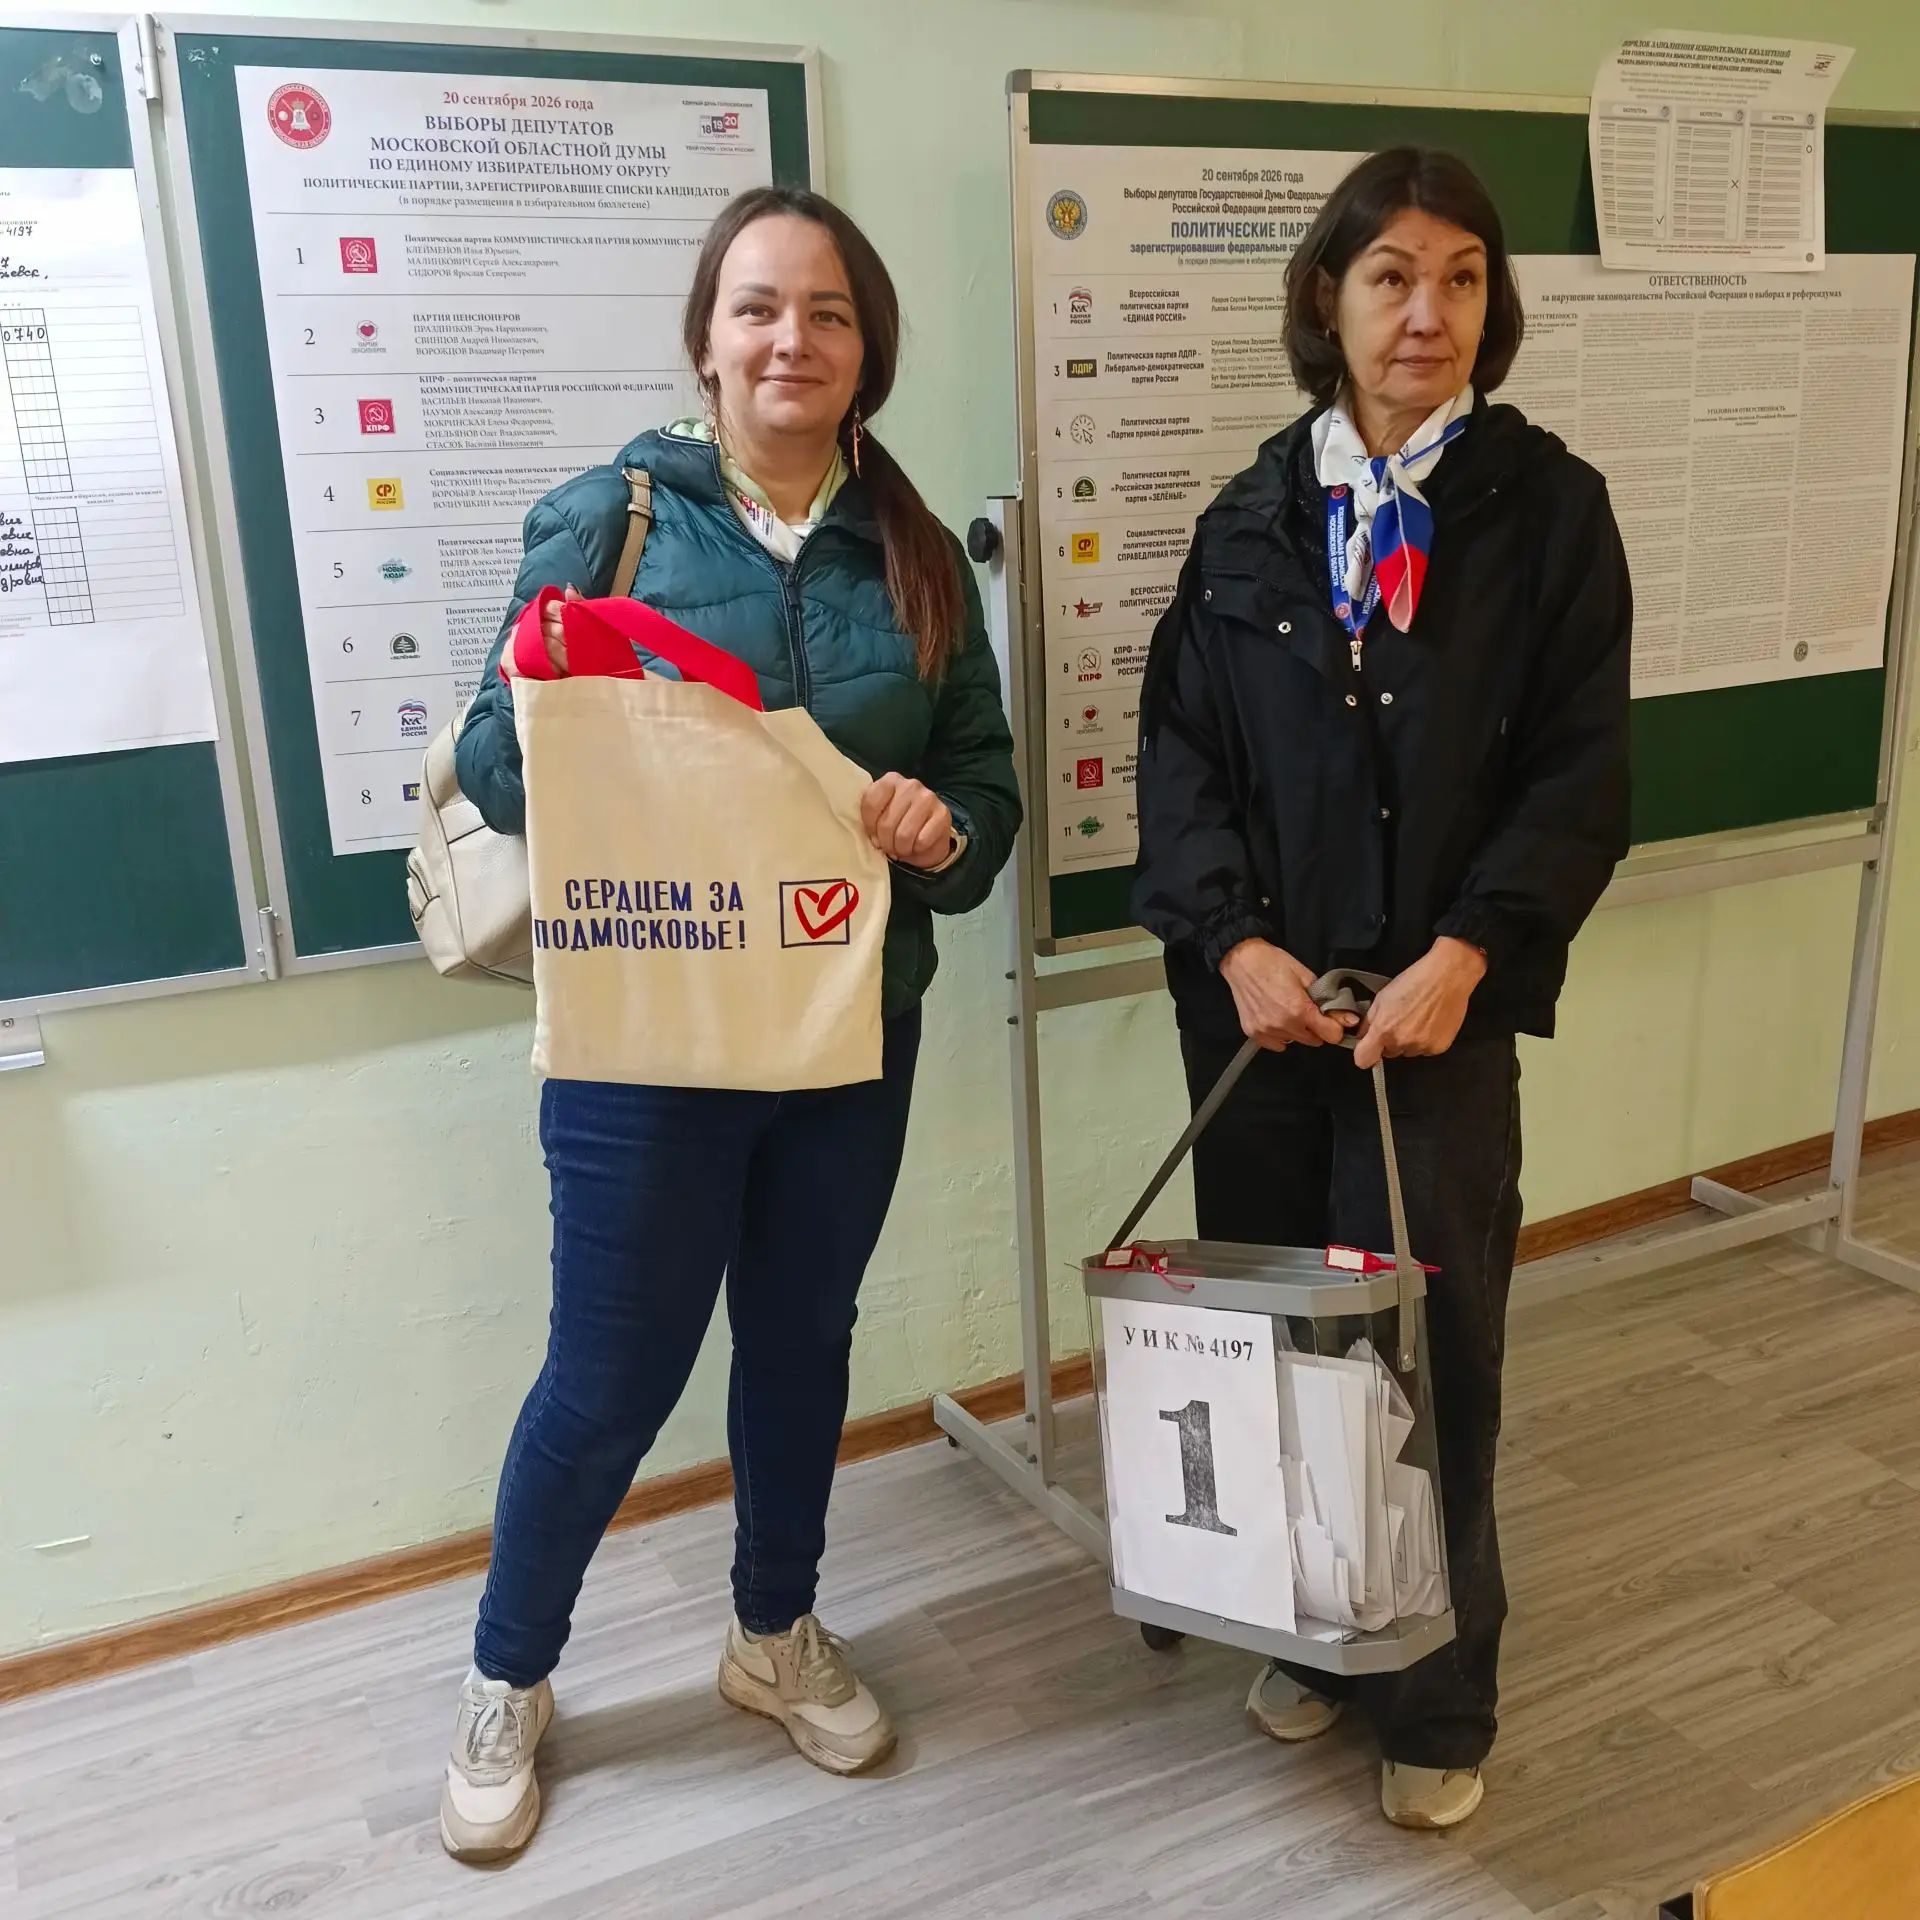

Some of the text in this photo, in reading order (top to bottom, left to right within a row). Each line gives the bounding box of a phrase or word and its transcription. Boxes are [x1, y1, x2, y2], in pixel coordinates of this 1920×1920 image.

[443, 91, 594, 112] 20 сентября 2026 года
[425, 116, 614, 136] ВЫБОРЫ ДЕПУТАТОВ
[713, 120, 723, 130] 19
[724, 116, 737, 126] 20
[702, 125, 711, 134] 18
[370, 137, 666, 160] МОСКОВСКОЙ ОБЛАСТНОЙ ДУМЫ
[369, 158, 670, 178] ПО ЕДИНОМУ ИЗБИРАТЕЛЬНОМУ ОКРУГУ
[1202, 168, 1304, 184] 20 сентября 2026 года
[303, 178, 730, 197] ПОЛИТИЧЕСКИЕ ПАРТИИ, ЗАРЕГИСТРИРОВАВШИЕ СПИСКИ КАНДИДАТОВ
[1123, 188, 1334, 203] Выборы депутатов Государственной Думы Федерально
[398, 195, 409, 206] (в
[411, 197, 452, 207] порядке
[453, 198, 514, 207] размещения
[524, 200, 596, 208] избирательном
[597, 199, 650, 209] бюллетене)
[1172, 203, 1302, 215] Российской Федерации девятого
[6, 226, 33, 237] 4197
[1171, 222, 1311, 240] ПОЛИТИЧЕСКИЕ ПАРТ
[404, 235, 463, 243] Политическая
[493, 235, 594, 244] КОММУНИСТИЧЕСКАЯ
[594, 237, 631, 245] ПАРТИЯ
[632, 237, 695, 246] КОММУНИСТЫ
[1130, 243, 1288, 254] зарегистрировавшие федеральные
[296, 248, 304, 265] 1
[408, 269, 452, 277] СИДОРОВ
[1649, 275, 1747, 286] ОТВЕТСТВЕННОСТЬ
[1129, 289, 1180, 298] Всероссийская
[1551, 294, 1596, 304] нарушение
[1596, 293, 1663, 301] законодательства
[1664, 290, 1707, 300] Российской
[1708, 290, 1748, 300] Федерации
[1754, 290, 1785, 300] выборах
[1792, 290, 1842, 300] референдумах
[1053, 303, 1057, 314] 1
[1119, 302, 1189, 311] политическая партия
[413, 314, 451, 322] ПАРТИЯ
[1122, 313, 1186, 323] «ЕДИНАЯ РОССИЯ»
[4, 327, 45, 342] 0740
[304, 328, 315, 344] 2
[414, 336, 459, 344] СВИНЦОВ
[1107, 349, 1197, 361] Политическая партия ЛДПР
[1054, 366, 1059, 377] 3
[1071, 362, 1094, 375] ЛДПР
[1104, 362, 1205, 373] Либерально-демократическая
[419, 375, 445, 383] КПРФ
[1131, 374, 1179, 384] партия России
[420, 383, 674, 394] КОММУНИСТИЧЕСКАЯ ПАРТИЯ РОССИЙСКОЙ ФЕДЕРАЦИИ
[314, 408, 324, 424] 3
[423, 418, 486, 427] МОКРИНСКАЯ
[1120, 417, 1190, 427] Политическая партия
[366, 424, 390, 432] КПРФ
[1055, 428, 1061, 438] 4
[1106, 428, 1204, 439] «Партия прямой демократии»
[425, 430, 479, 438] ЕМЕЛЬЯНОВ
[558, 466, 586, 474] партия
[1122, 470, 1190, 480] Политическая партия
[1110, 482, 1153, 492] «Российская
[1154, 480, 1201, 490] экологическая
[323, 485, 335, 501] 4
[1057, 488, 1063, 498] 5
[1125, 491, 1187, 504] партия «ЗЕЛЁНЫЕ»
[0, 512, 22, 526] вич
[1, 527, 34, 540] евич
[1126, 528, 1186, 538] Социалистическая
[437, 537, 524, 546] Политическая партия
[1122, 538, 1192, 550] политическая партия
[1059, 546, 1064, 557] 6
[1117, 550, 1169, 562] СПРАВЕДЛИВАЯ
[334, 563, 344, 578] 5
[441, 568, 512, 578] СОЛДАТОВ Юрий
[1331, 557, 1339, 587] ОБЛАСТИ
[1130, 584, 1178, 596] ВСЕРОССИЙСК
[1119, 596, 1170, 608] ПОЛИТИЧЕСКАЯ
[445, 606, 501, 615] Политическая
[1061, 605, 1066, 615] 7
[448, 626, 498, 636] ШАХМАТОВ
[343, 637, 353, 653] 6
[449, 637, 480, 647] СЫРОВ
[1113, 645, 1133, 654] КПРФ
[451, 658, 482, 667] ПОПОВ
[1063, 663, 1068, 673] 8
[1078, 673, 1102, 682] КПРФ
[351, 710, 361, 726] 7
[1123, 711, 1139, 720] ПАРТ
[1064, 719, 1070, 729] 9
[1063, 773, 1071, 783] 10
[362, 790, 372, 804] 8
[1064, 827, 1071, 837] 11
[565, 879, 744, 914] СЕРДЦЕМ ЗА
[534, 917, 746, 951] ПОДМОСКОВЬЕ!
[1210, 1338, 1253, 1360] 4197
[1159, 1400, 1237, 1536] 1
